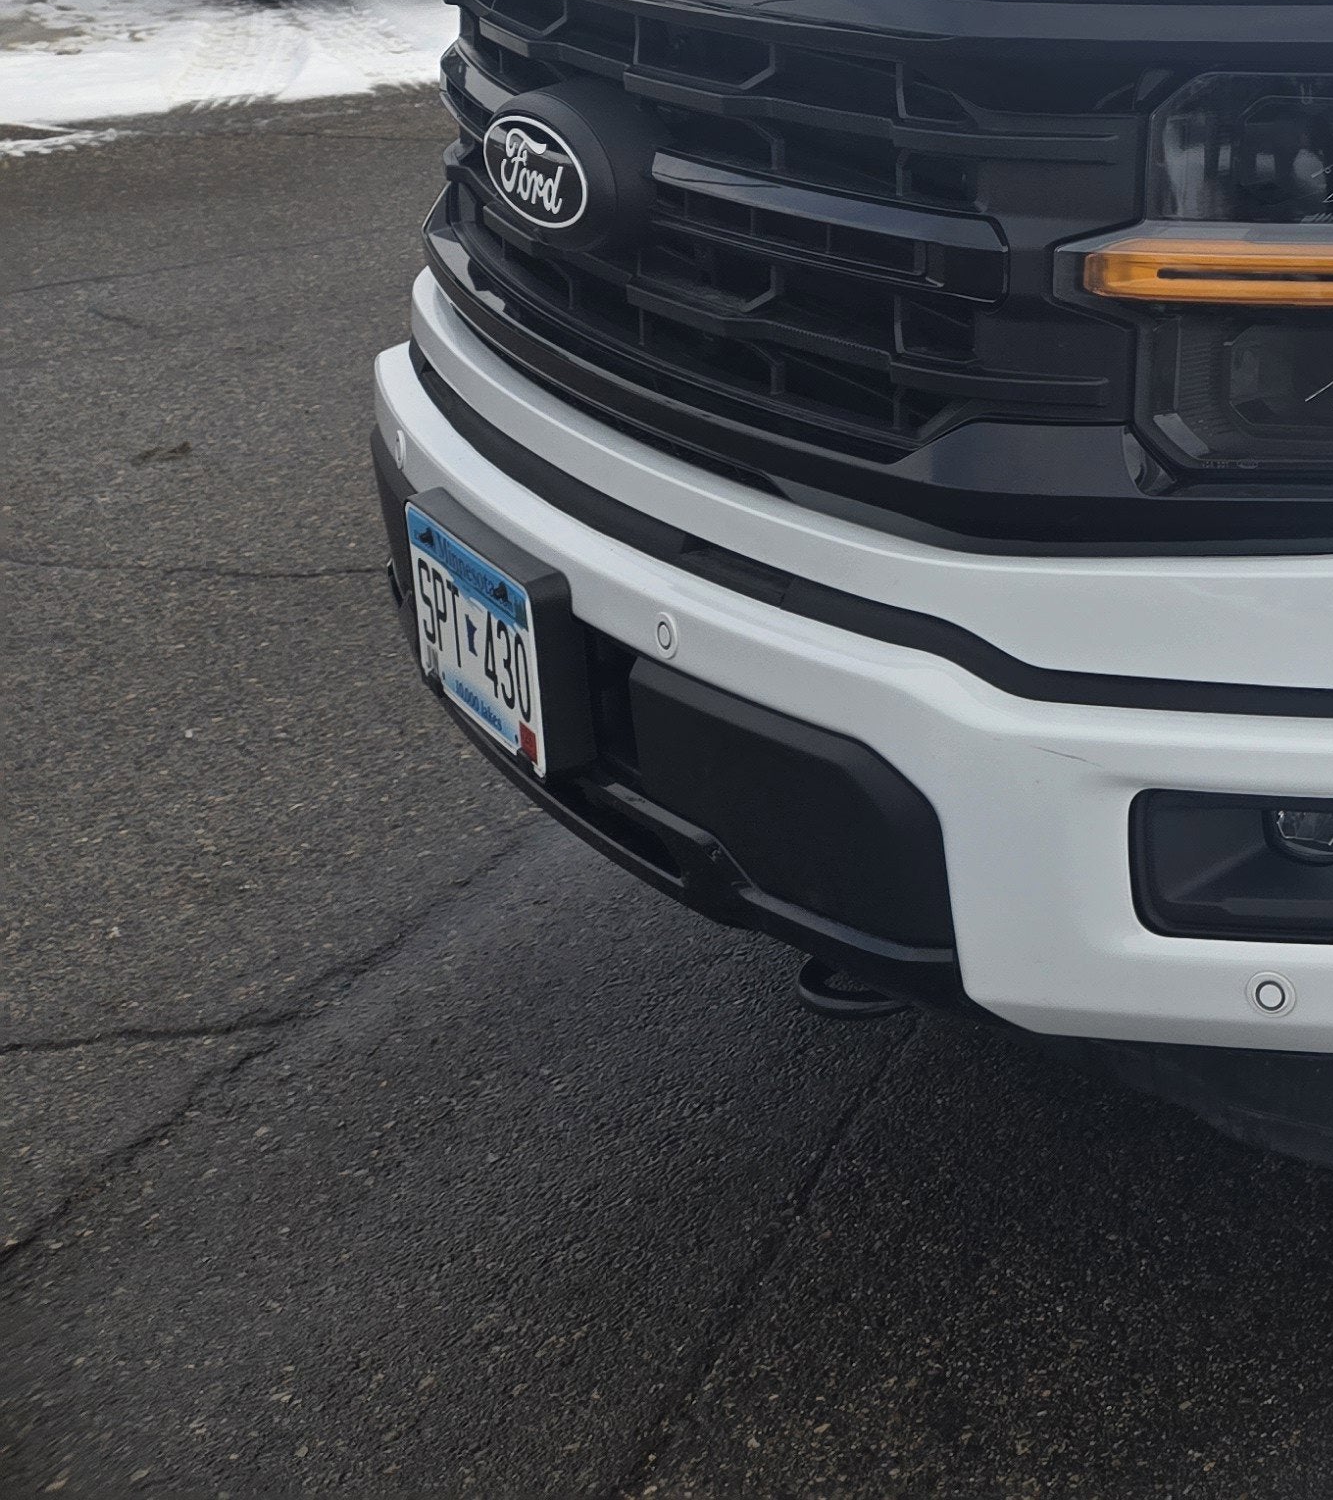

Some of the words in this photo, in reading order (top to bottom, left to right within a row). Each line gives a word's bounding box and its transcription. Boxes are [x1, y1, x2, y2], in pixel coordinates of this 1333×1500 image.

[500, 127, 563, 215] Ford
[433, 529, 495, 596] Minnesota
[417, 557, 462, 668] SPT
[484, 610, 531, 724] 430
